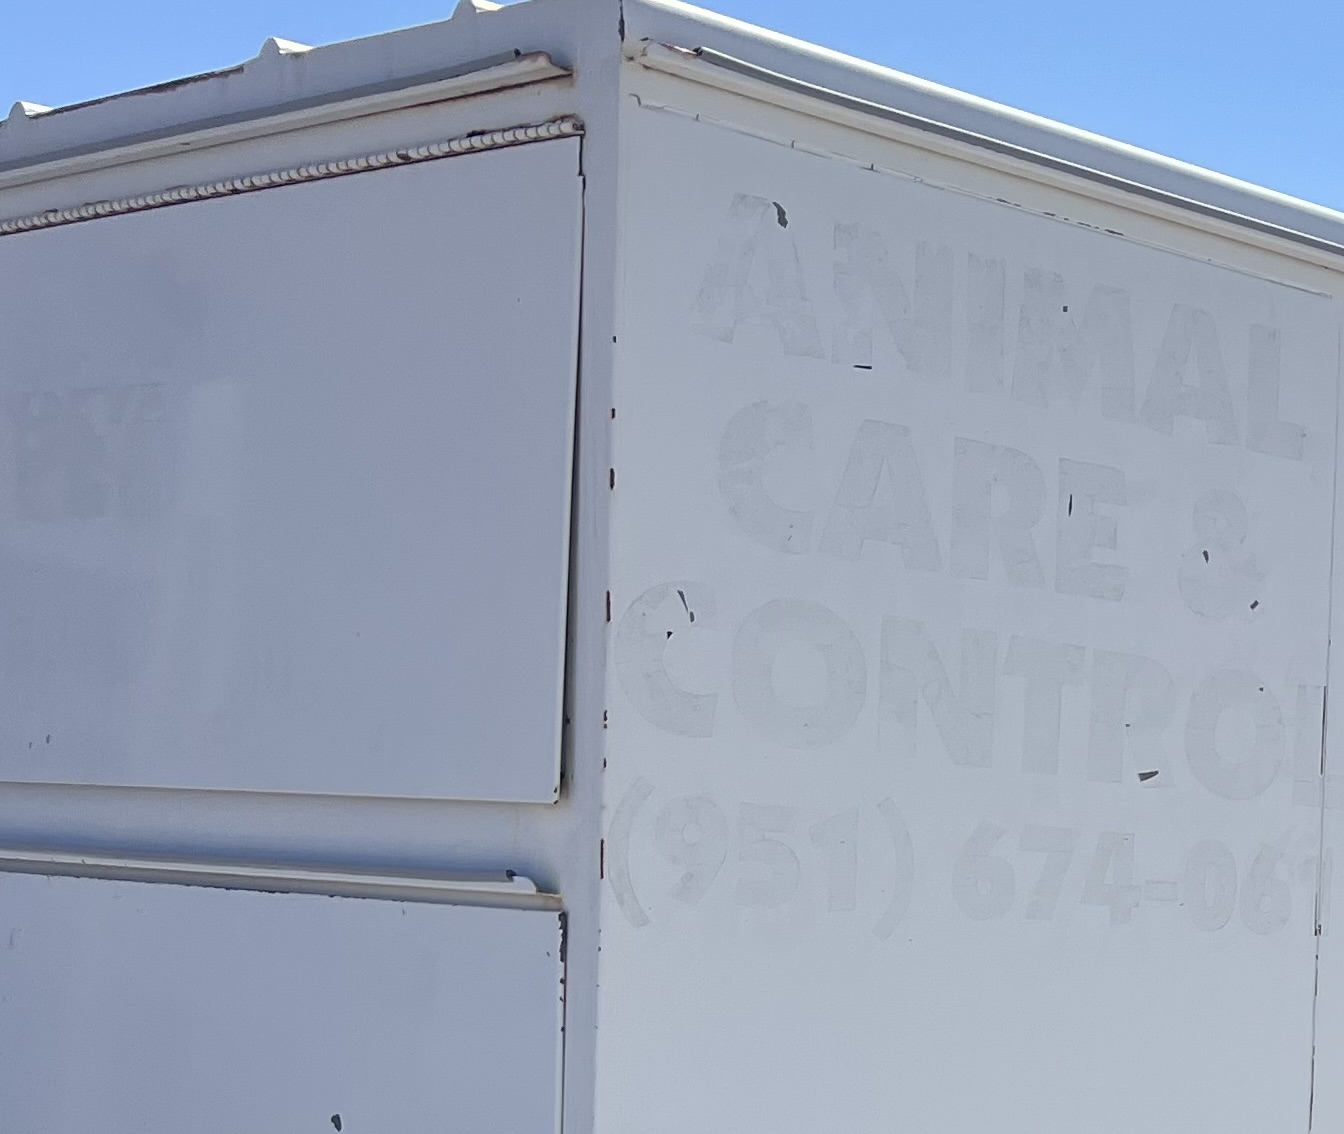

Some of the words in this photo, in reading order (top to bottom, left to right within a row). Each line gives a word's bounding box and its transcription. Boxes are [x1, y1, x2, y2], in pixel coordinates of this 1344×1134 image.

[690, 191, 1311, 461] ANIMAL
[716, 397, 1130, 603] CARE
[1177, 487, 1268, 623] &
[606, 774, 915, 942] (951)
